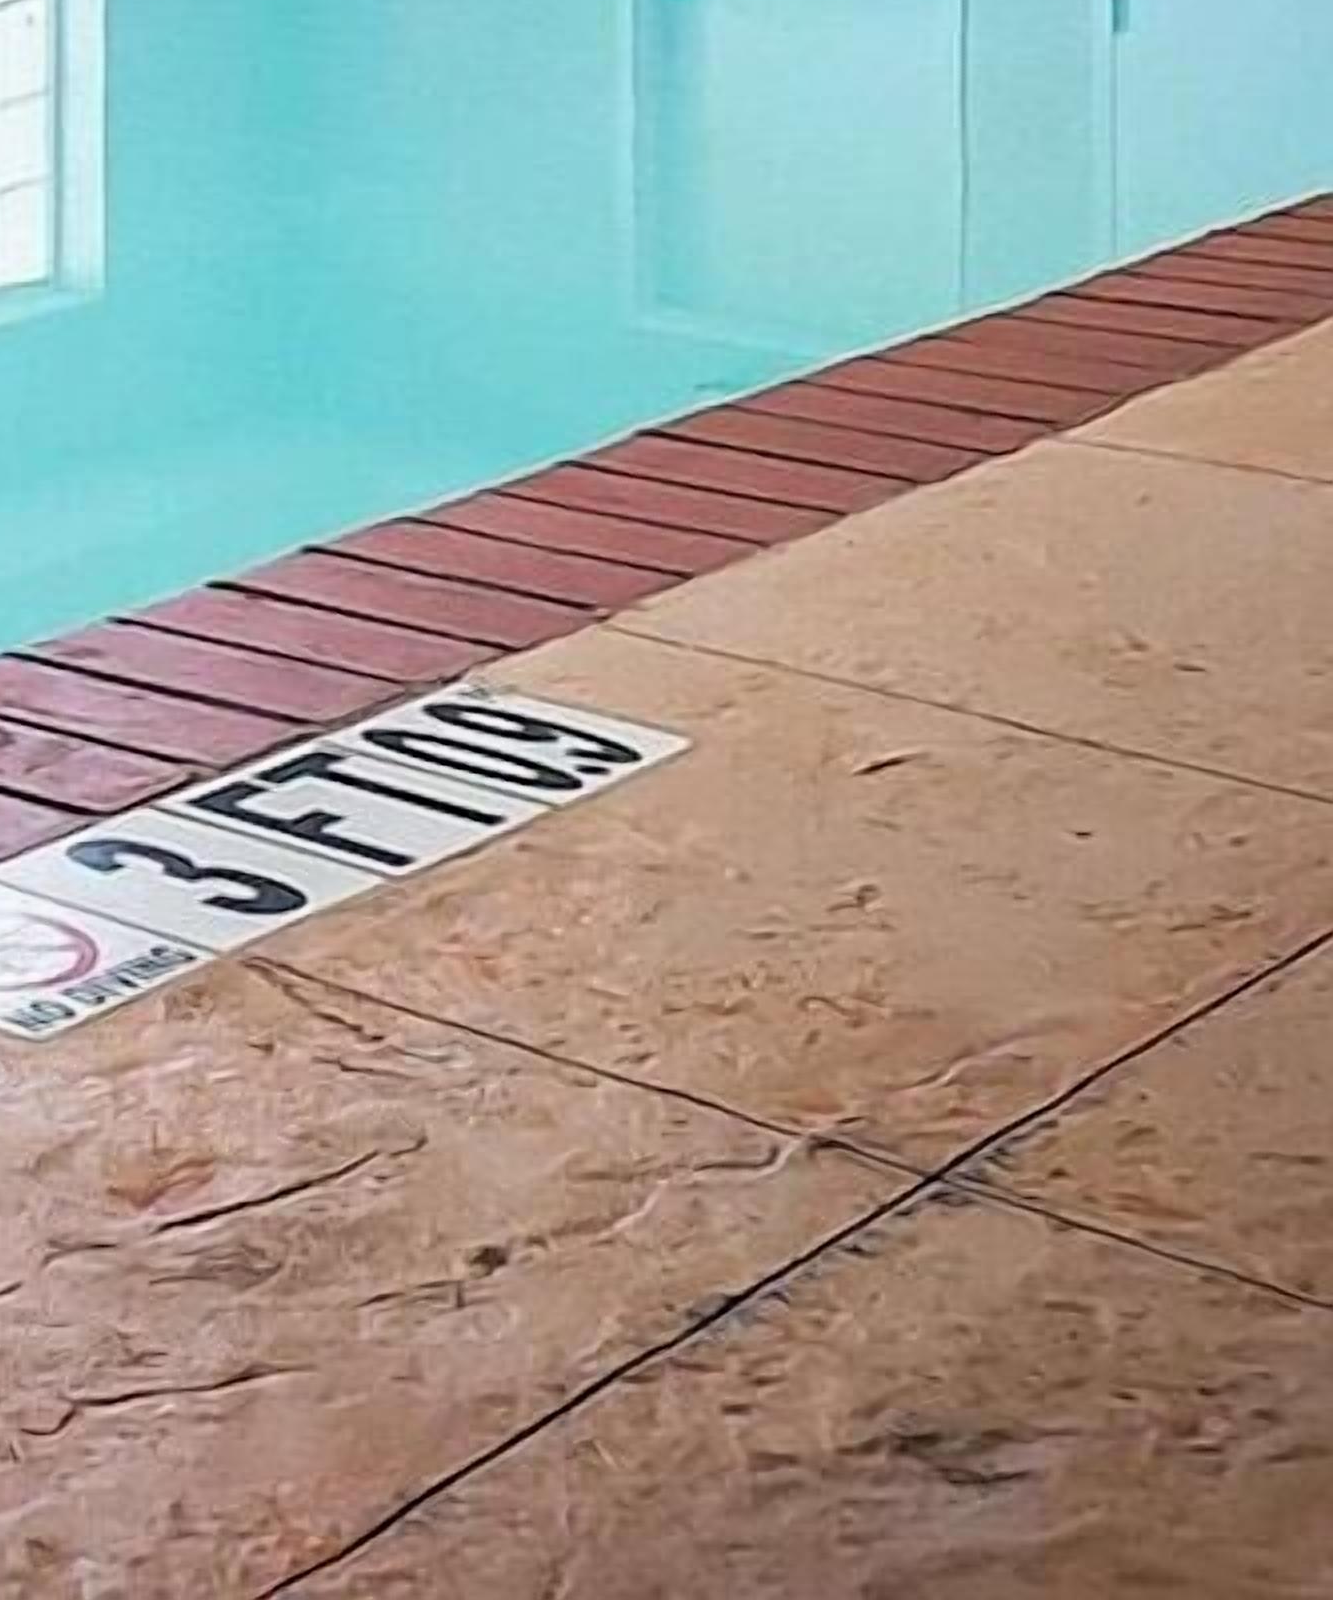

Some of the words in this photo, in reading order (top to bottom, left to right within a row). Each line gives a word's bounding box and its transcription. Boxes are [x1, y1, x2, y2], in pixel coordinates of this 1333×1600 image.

[65, 838, 308, 916] 3
[189, 751, 507, 867] FT
[1, 1000, 76, 1031] NO
[61, 945, 198, 1005] DIVING
